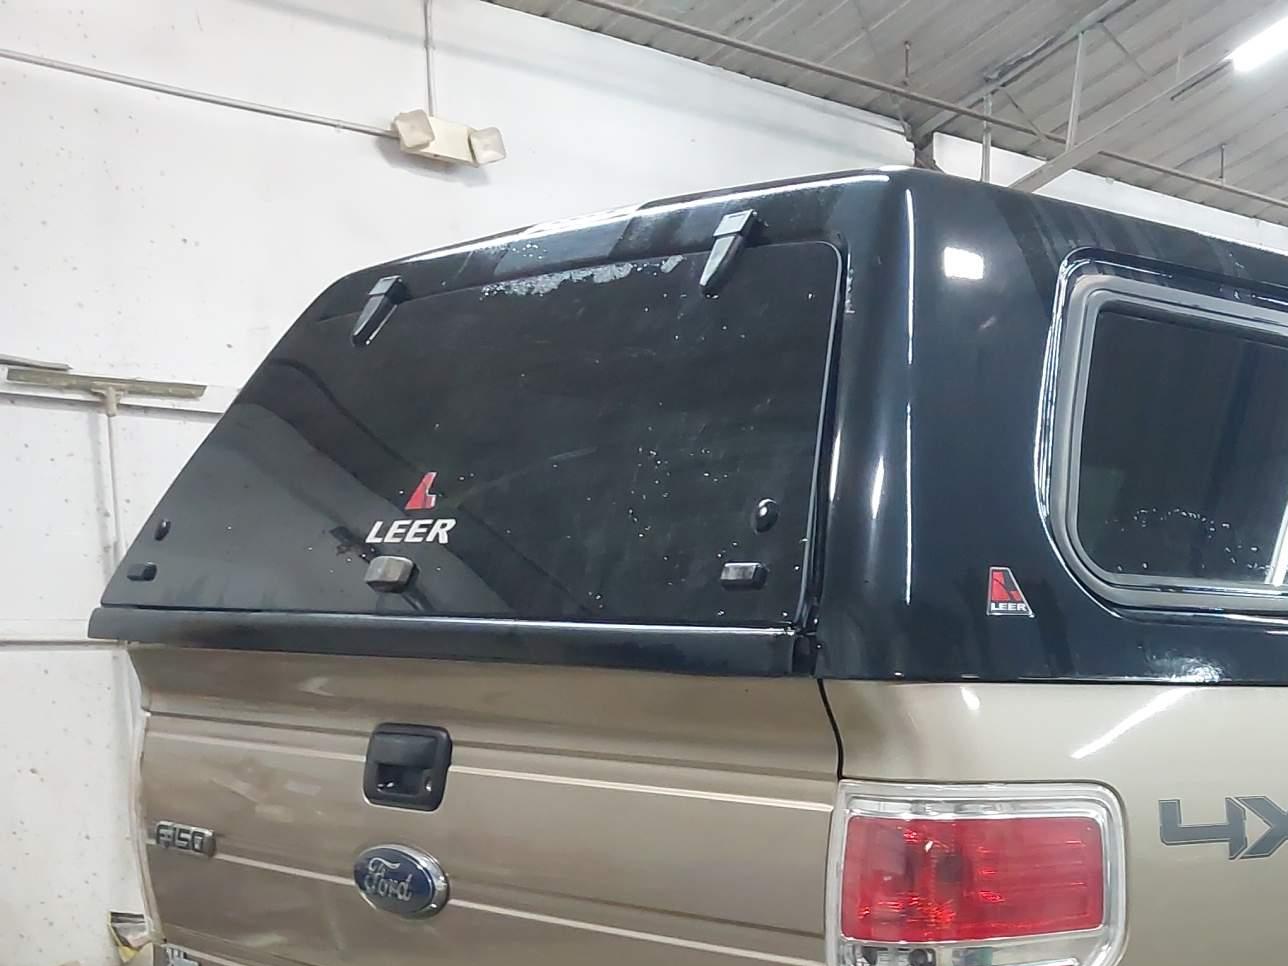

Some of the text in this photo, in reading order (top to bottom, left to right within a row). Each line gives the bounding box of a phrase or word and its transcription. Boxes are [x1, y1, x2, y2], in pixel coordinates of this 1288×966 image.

[365, 518, 456, 544] LEER
[990, 602, 1027, 611] LEER
[364, 856, 413, 901] Ford
